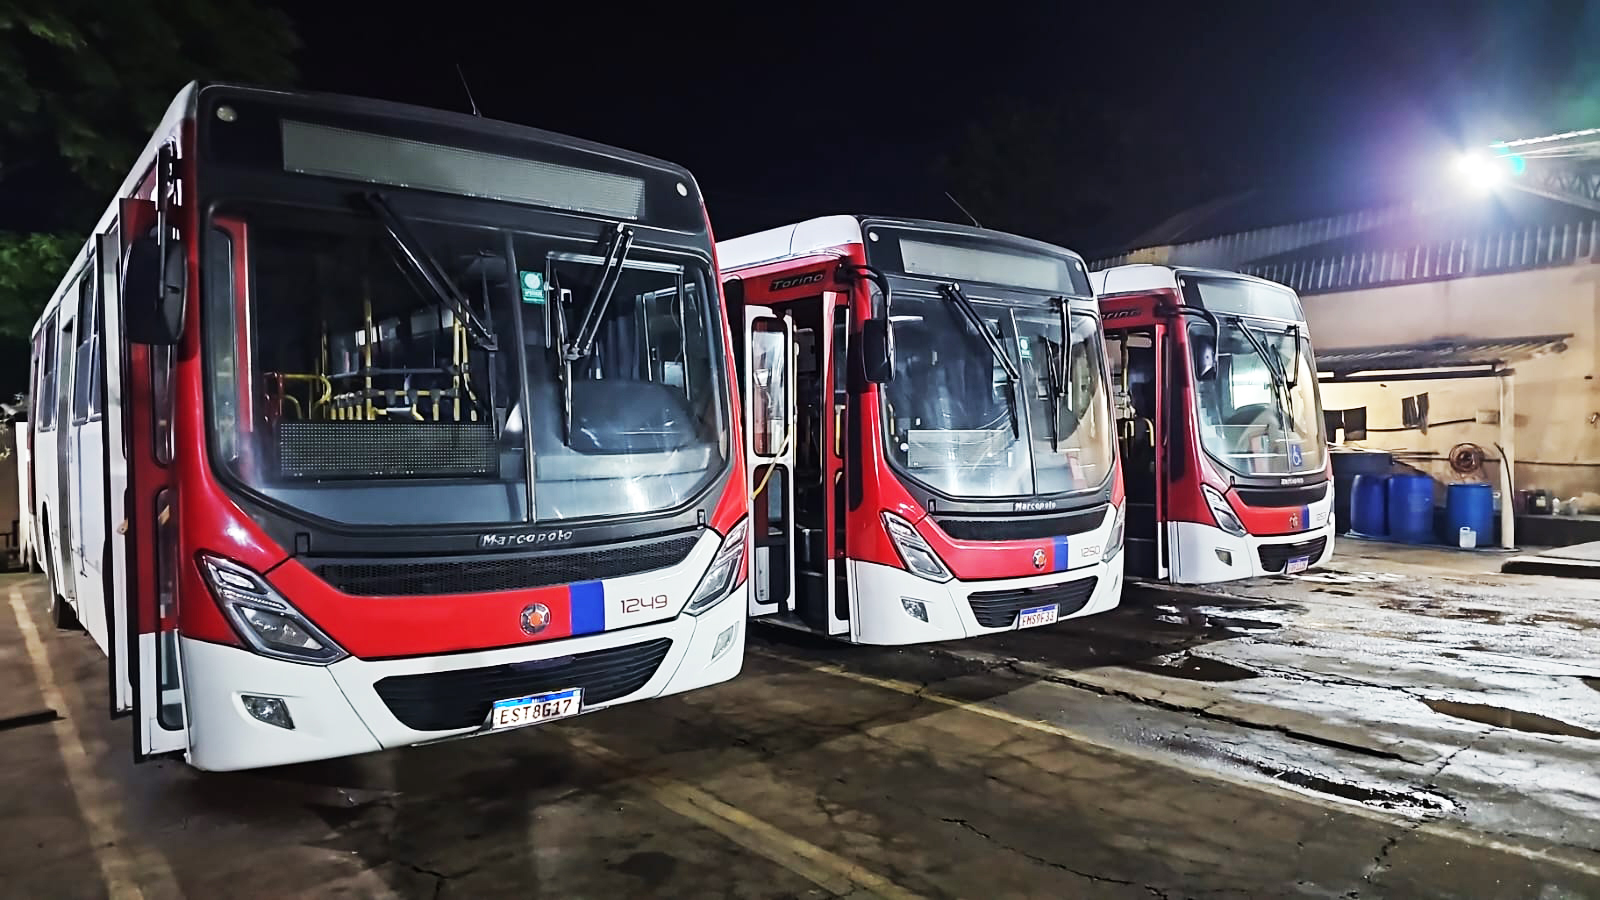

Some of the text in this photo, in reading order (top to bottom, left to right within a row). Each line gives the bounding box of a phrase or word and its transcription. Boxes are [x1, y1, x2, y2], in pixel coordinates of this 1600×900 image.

[774, 273, 824, 290] Torino
[482, 529, 573, 547] Marcopolo
[620, 594, 668, 614] 1249
[500, 699, 572, 725] EST8G17
